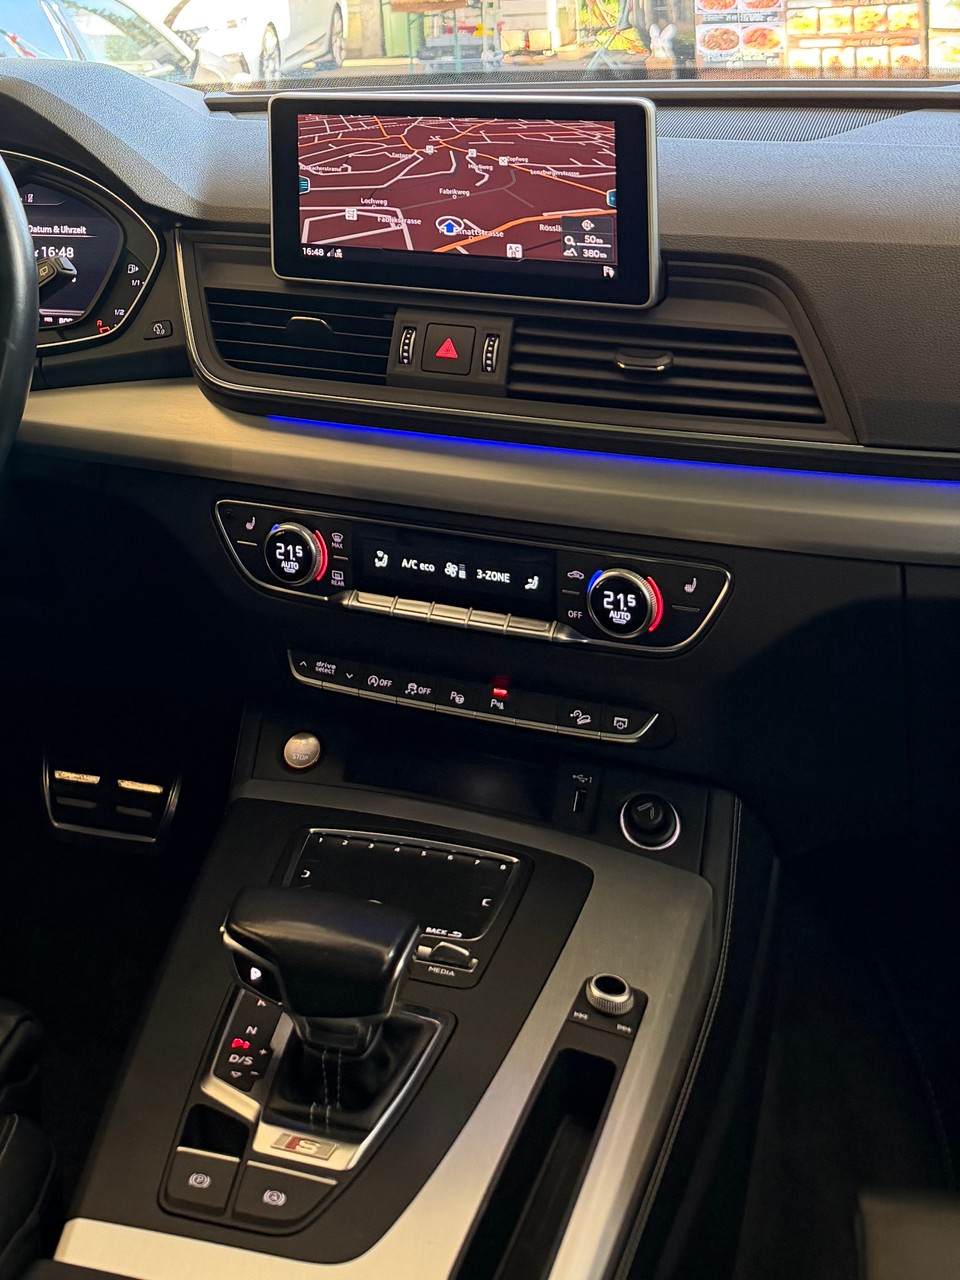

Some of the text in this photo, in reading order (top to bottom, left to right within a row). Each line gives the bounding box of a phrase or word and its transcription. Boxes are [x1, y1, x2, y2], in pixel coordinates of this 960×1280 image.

[439, 188, 470, 196] Fabrikweg
[360, 197, 388, 206] Lochweg
[53, 225, 60, 234] &
[60, 225, 87, 234] Uhrzeit
[539, 223, 562, 232] Rössli
[41, 246, 74, 258] 16:48
[302, 247, 325, 257] 16:48
[275, 542, 303, 561] 21.5
[280, 560, 299, 570] AUTO
[401, 558, 435, 572] A/C eco
[476, 569, 511, 583] 3-ZONE
[330, 579, 345, 587] REAR
[603, 590, 637, 611] 21.5
[567, 610, 583, 619] OFF
[609, 610, 631, 621] AUTO
[315, 661, 337, 670] drive
[315, 666, 336, 675] select
[379, 679, 393, 687] OFF
[418, 686, 432, 695] OFF
[291, 753, 309, 761] STOP
[425, 926, 448, 936] BACK
[427, 965, 455, 977] MEDIA
[245, 1025, 258, 1035] N
[228, 1053, 254, 1066] D/S
